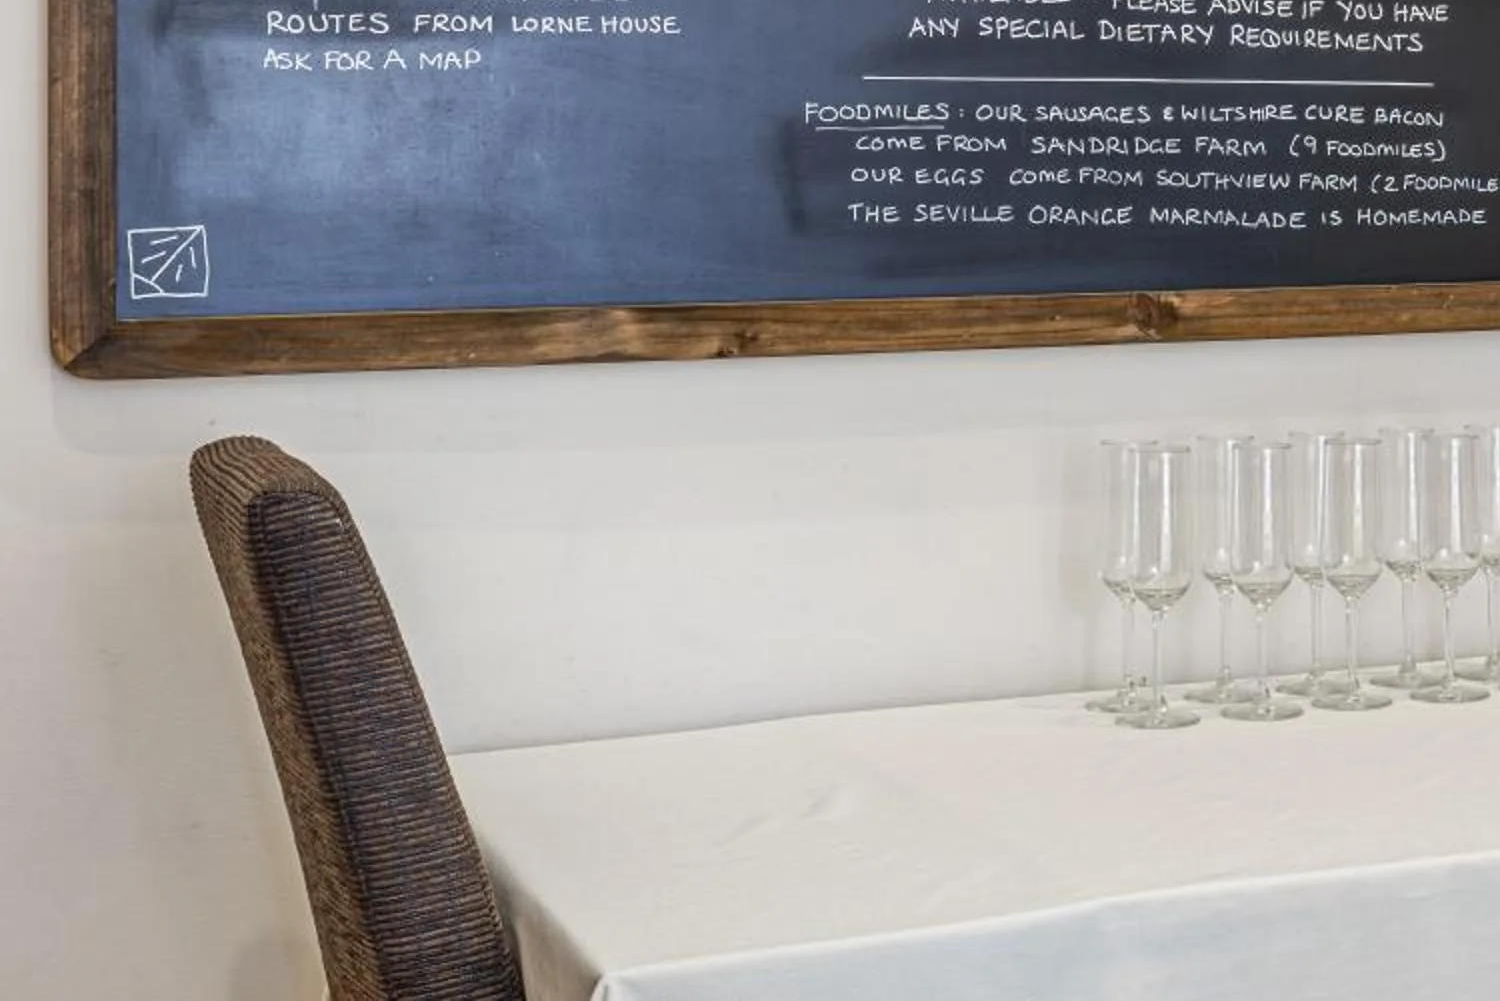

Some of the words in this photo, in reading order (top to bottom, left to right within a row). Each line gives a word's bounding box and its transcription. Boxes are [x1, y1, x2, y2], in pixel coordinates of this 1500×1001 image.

[909, 17, 959, 38] ANY
[979, 16, 1085, 40] SPECIAL
[1098, 19, 1214, 45] DIETARY
[1230, 23, 1423, 52] REQUIREMENTS
[848, 203, 900, 223] THE
[914, 204, 1014, 222] SEVILLE
[1028, 205, 1133, 225] ORANGE
[1150, 207, 1306, 229] MARMALADE
[1322, 210, 1343, 226] IS
[1357, 208, 1487, 226] HOMEMADE
